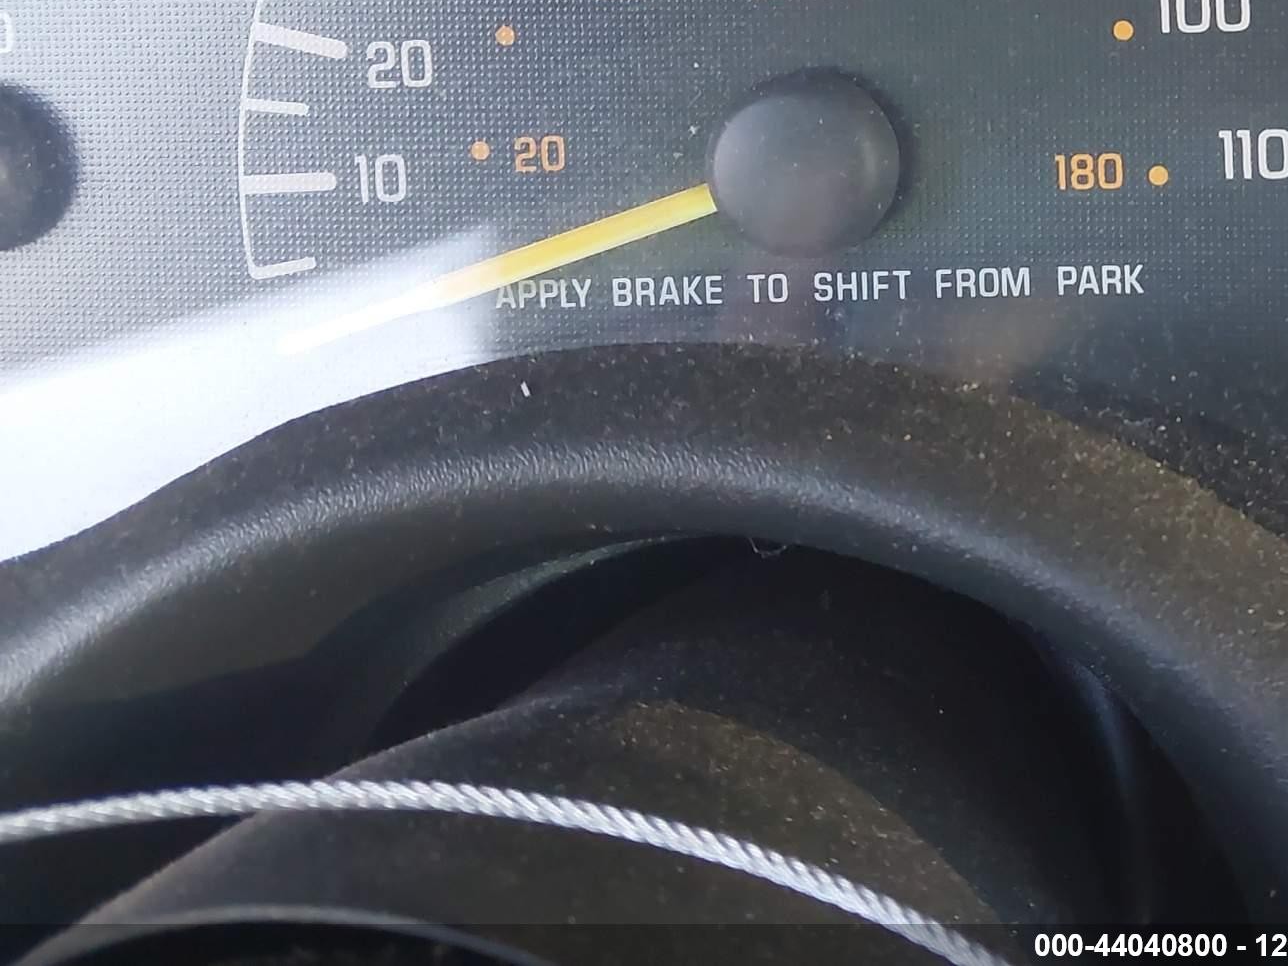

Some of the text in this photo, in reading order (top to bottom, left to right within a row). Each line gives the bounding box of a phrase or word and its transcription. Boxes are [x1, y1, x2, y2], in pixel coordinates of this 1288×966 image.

[366, 39, 432, 88] 20
[514, 136, 566, 172] 20
[1055, 154, 1123, 190] 180
[354, 154, 407, 202] 10
[497, 264, 1143, 309] APPLY BRAKE TO SHIFT FROM PARK
